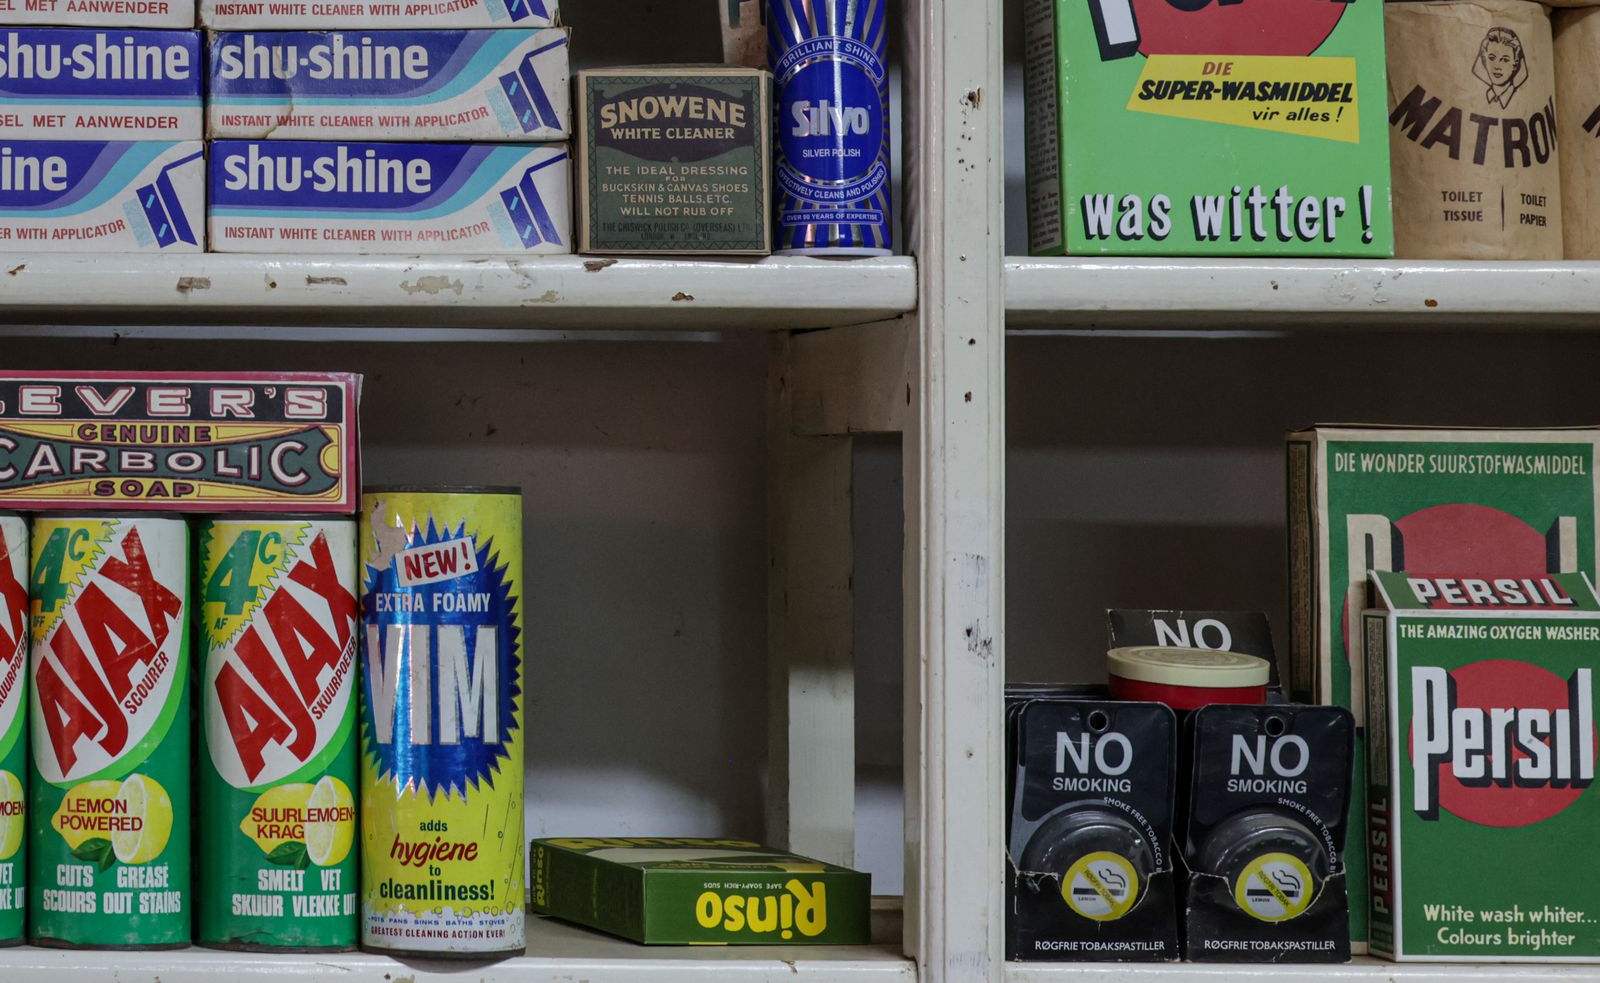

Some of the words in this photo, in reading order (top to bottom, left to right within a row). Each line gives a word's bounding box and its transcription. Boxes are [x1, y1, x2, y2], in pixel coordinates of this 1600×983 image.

[1202, 61, 1233, 76] DIE
[1138, 81, 1353, 103] SUPER-WASMIDDEL
[601, 95, 746, 129] SNOWENE
[1252, 108, 1280, 122] vir
[610, 128, 661, 139] WHITE
[666, 127, 735, 139] CLEANER
[802, 148, 829, 158] SILVER
[832, 148, 860, 157] POLISH
[1442, 191, 1483, 202] TOILET
[620, 206, 650, 215] WILL
[654, 206, 679, 215] NOT
[683, 206, 708, 215] RUB
[711, 206, 733, 215] OFF
[1081, 191, 1171, 241] was
[1194, 185, 1346, 242] witter
[1443, 211, 1483, 221] TISSUE
[1519, 214, 1547, 227] PAPIER
[77, 423, 211, 442] GENUINE
[1335, 453, 1356, 472] DIE
[1360, 453, 1424, 474] WONDER
[1429, 454, 1586, 476] SUURSTOFWASMIDDEL
[94, 480, 195, 497] SOAP
[402, 539, 470, 579] NEW!
[1406, 578, 1578, 607] PERSIL
[375, 593, 425, 613] EXTRA
[433, 593, 490, 613] FOAMY
[1400, 625, 1423, 638] THE
[1427, 625, 1486, 640] AMAZING
[1490, 626, 1540, 640] OXYGEN
[1545, 626, 1600, 641] WASHER
[37, 525, 182, 778] AJAX
[124, 650, 169, 716] SCOURER
[367, 624, 498, 746] VIM
[1412, 666, 1594, 820] Persil
[1055, 732, 1133, 776] NO
[1052, 777, 1132, 794] SMOKING
[67, 798, 128, 814] LEMON
[60, 815, 143, 831] POWERED
[391, 838, 478, 862] hygiene
[379, 879, 495, 902] cleanliness!
[696, 879, 827, 939] Rinso
[1035, 940, 1078, 952] RØGFRIE
[1080, 940, 1165, 952] TOBAKSPASTILLER
[1437, 928, 1502, 945] Colours
[1506, 929, 1574, 950] brighter
